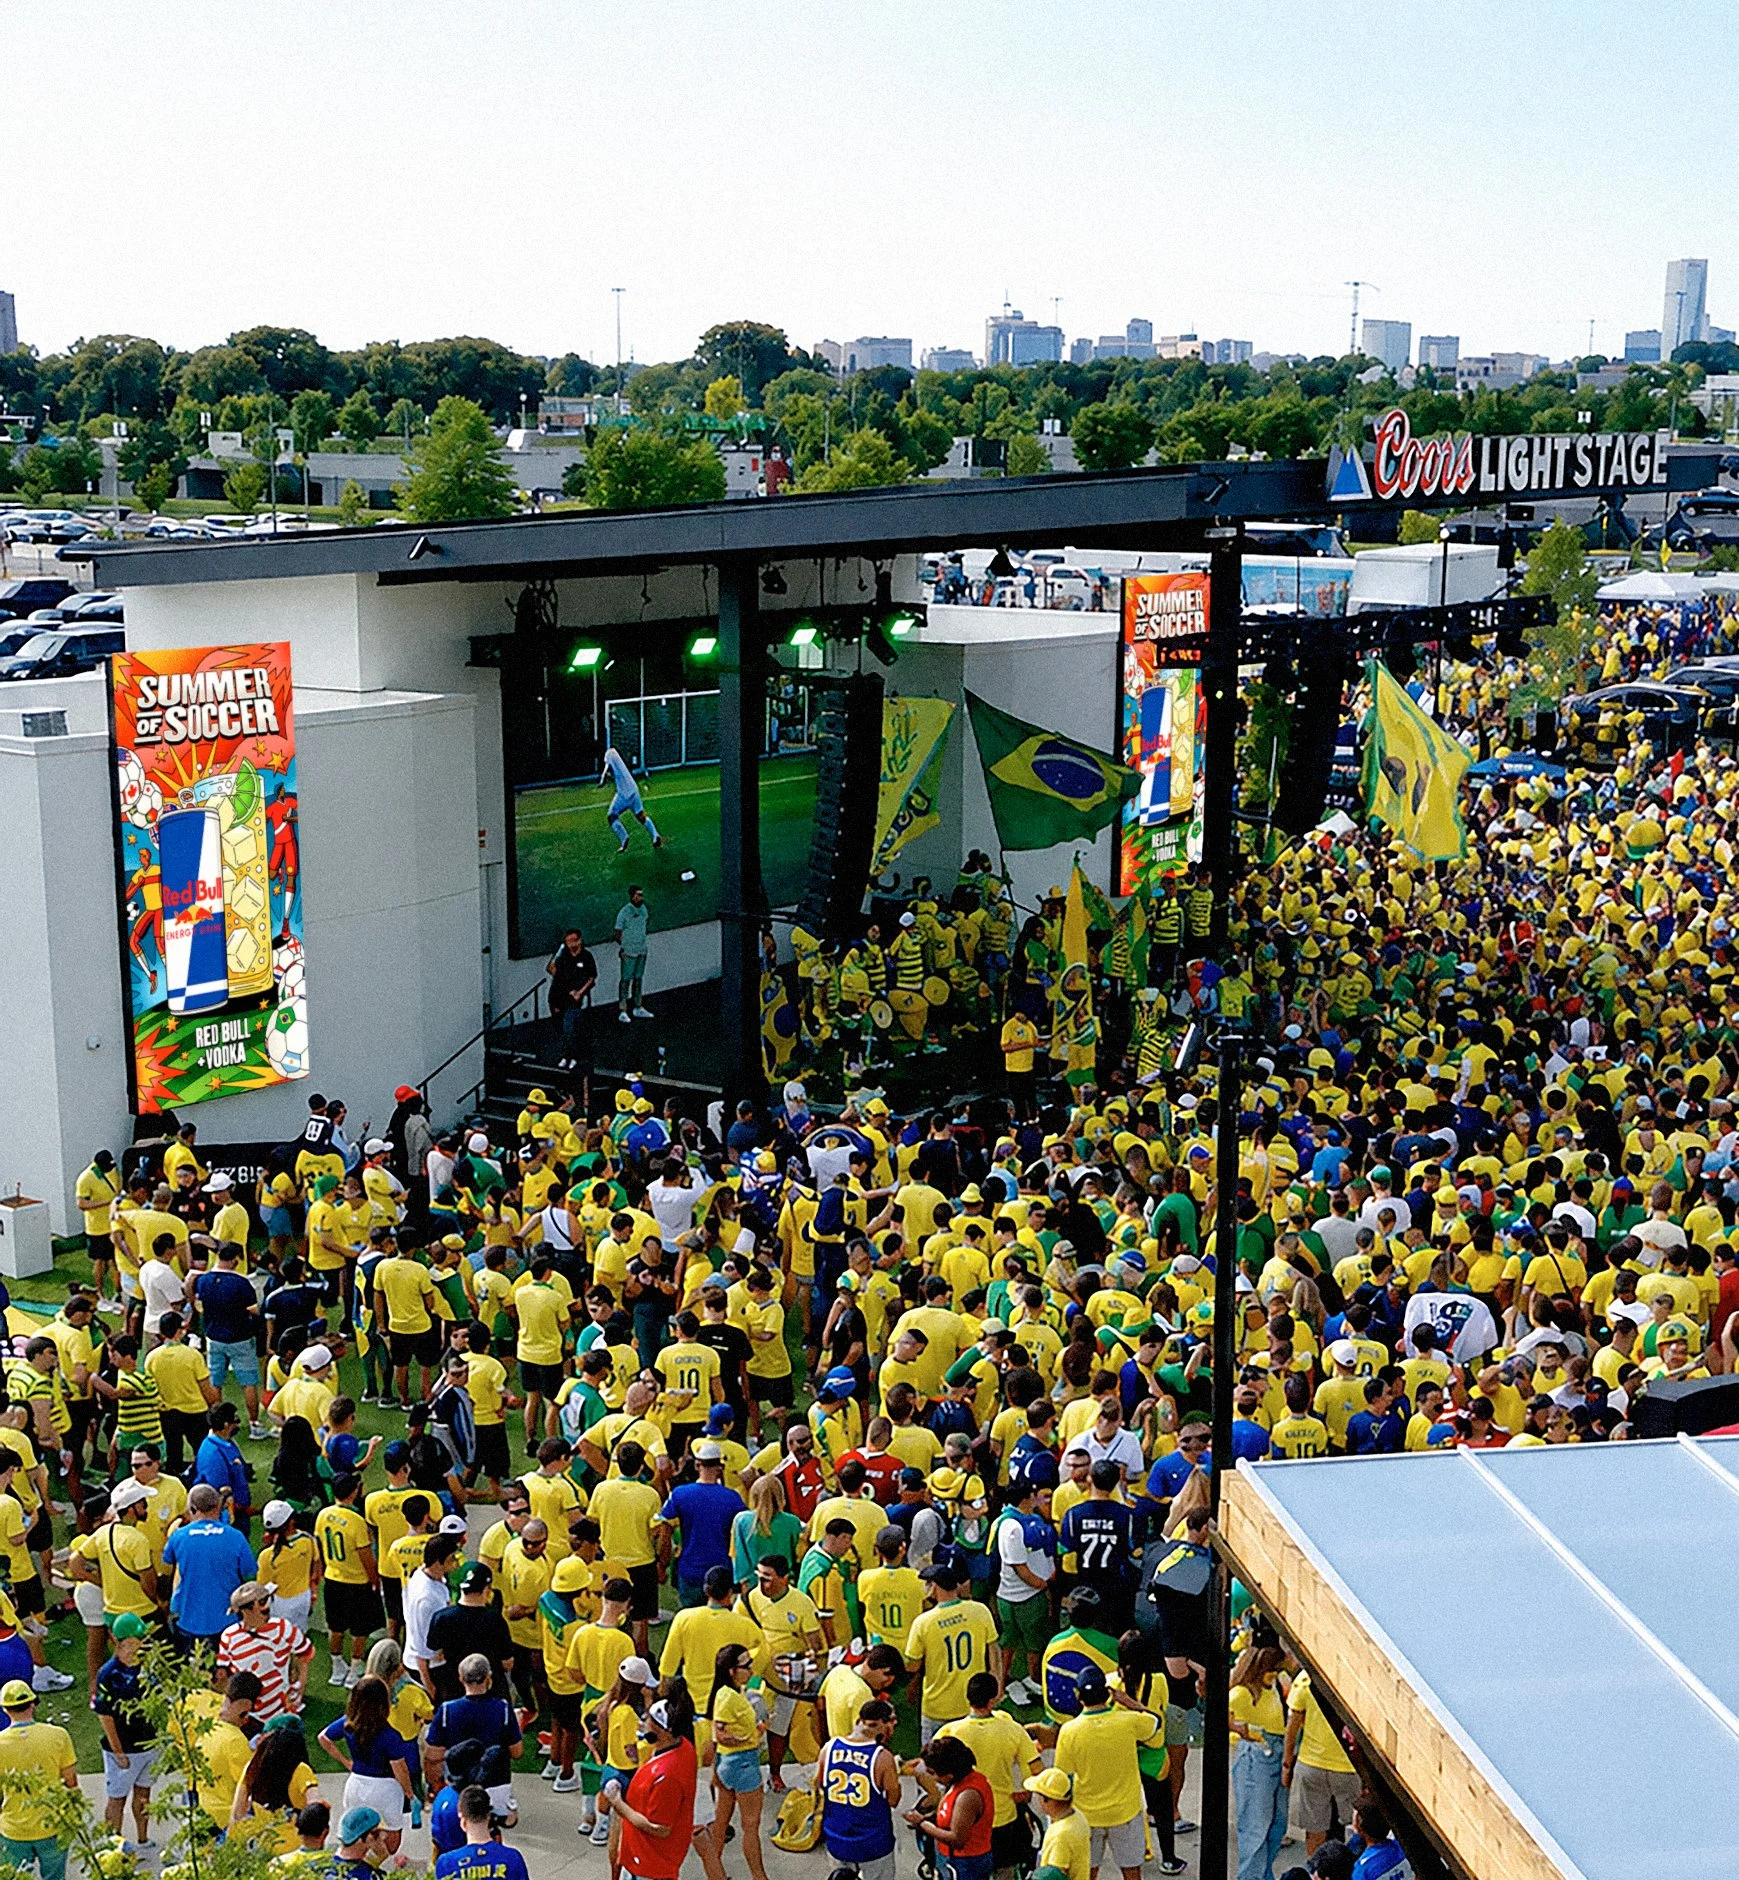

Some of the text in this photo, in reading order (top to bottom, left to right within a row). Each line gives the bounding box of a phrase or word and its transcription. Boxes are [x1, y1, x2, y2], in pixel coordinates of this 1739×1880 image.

[1374, 409, 1667, 500] Coors LIGHT STAGE
[1136, 589, 1203, 616] SUMMER
[1135, 611, 1206, 639] OF SOCCER
[137, 667, 272, 709] SUMMER
[136, 699, 280, 742] OF SOCCER
[1151, 828, 1180, 848] RED BULL
[163, 876, 223, 907] Red Bull
[196, 1017, 251, 1048] RED BULL
[679, 1368, 700, 1397] 10
[325, 1526, 346, 1561] 10
[1080, 1533, 1118, 1568] 77
[880, 1603, 902, 1628] 10
[943, 1631, 973, 1673] 10
[828, 1769, 870, 1807] 23
